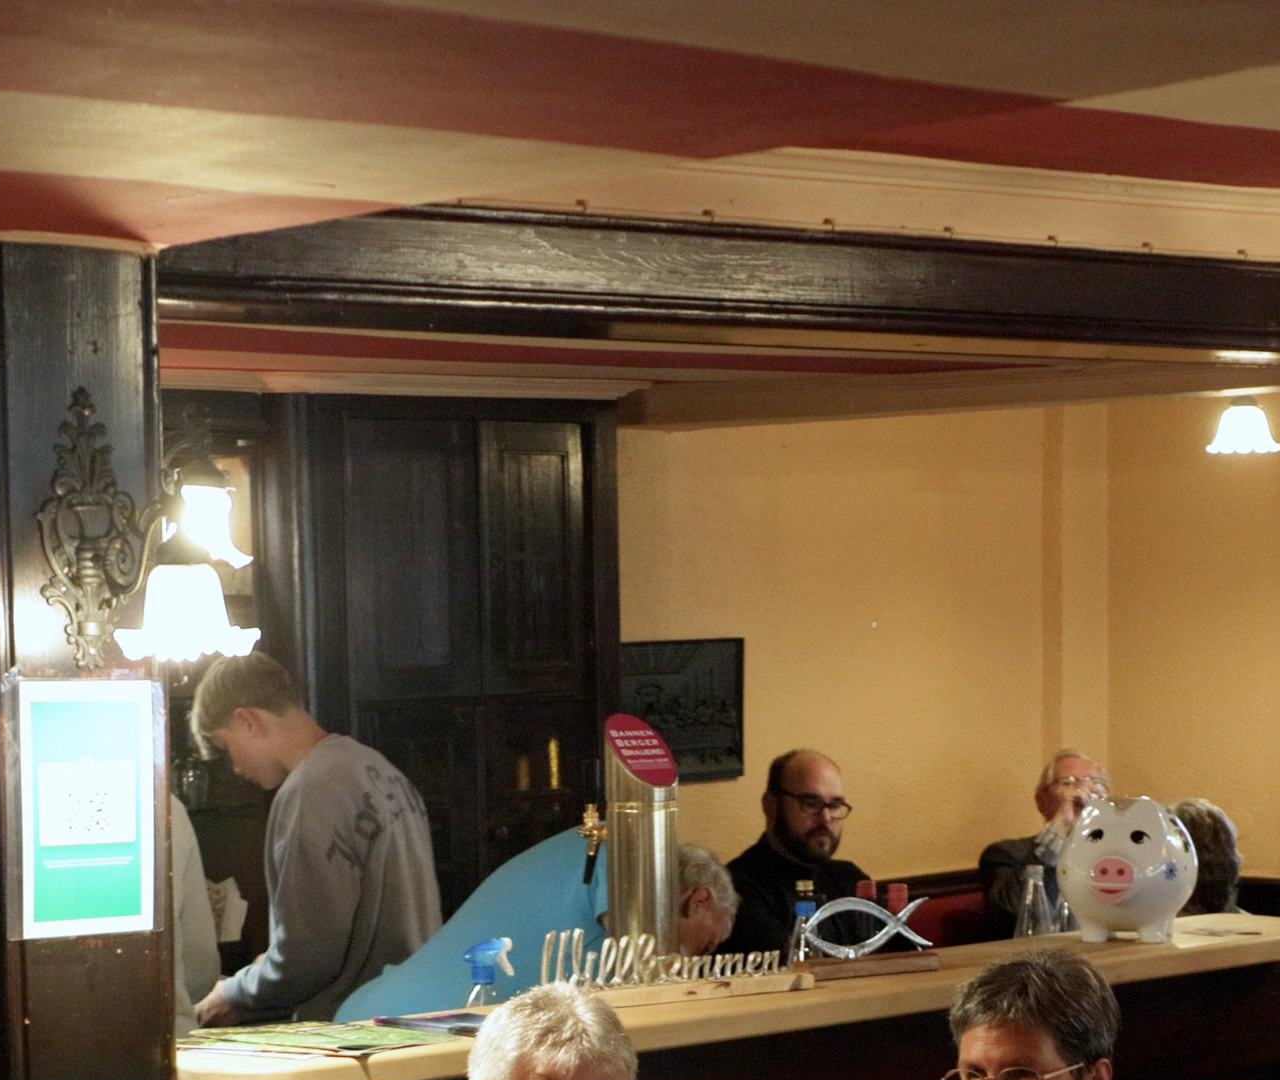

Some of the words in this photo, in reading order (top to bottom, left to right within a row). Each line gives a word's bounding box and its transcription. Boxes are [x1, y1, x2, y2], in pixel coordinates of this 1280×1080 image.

[609, 729, 654, 737] BANNEN
[614, 738, 659, 747] BERGER
[540, 927, 788, 990] Willkommen
